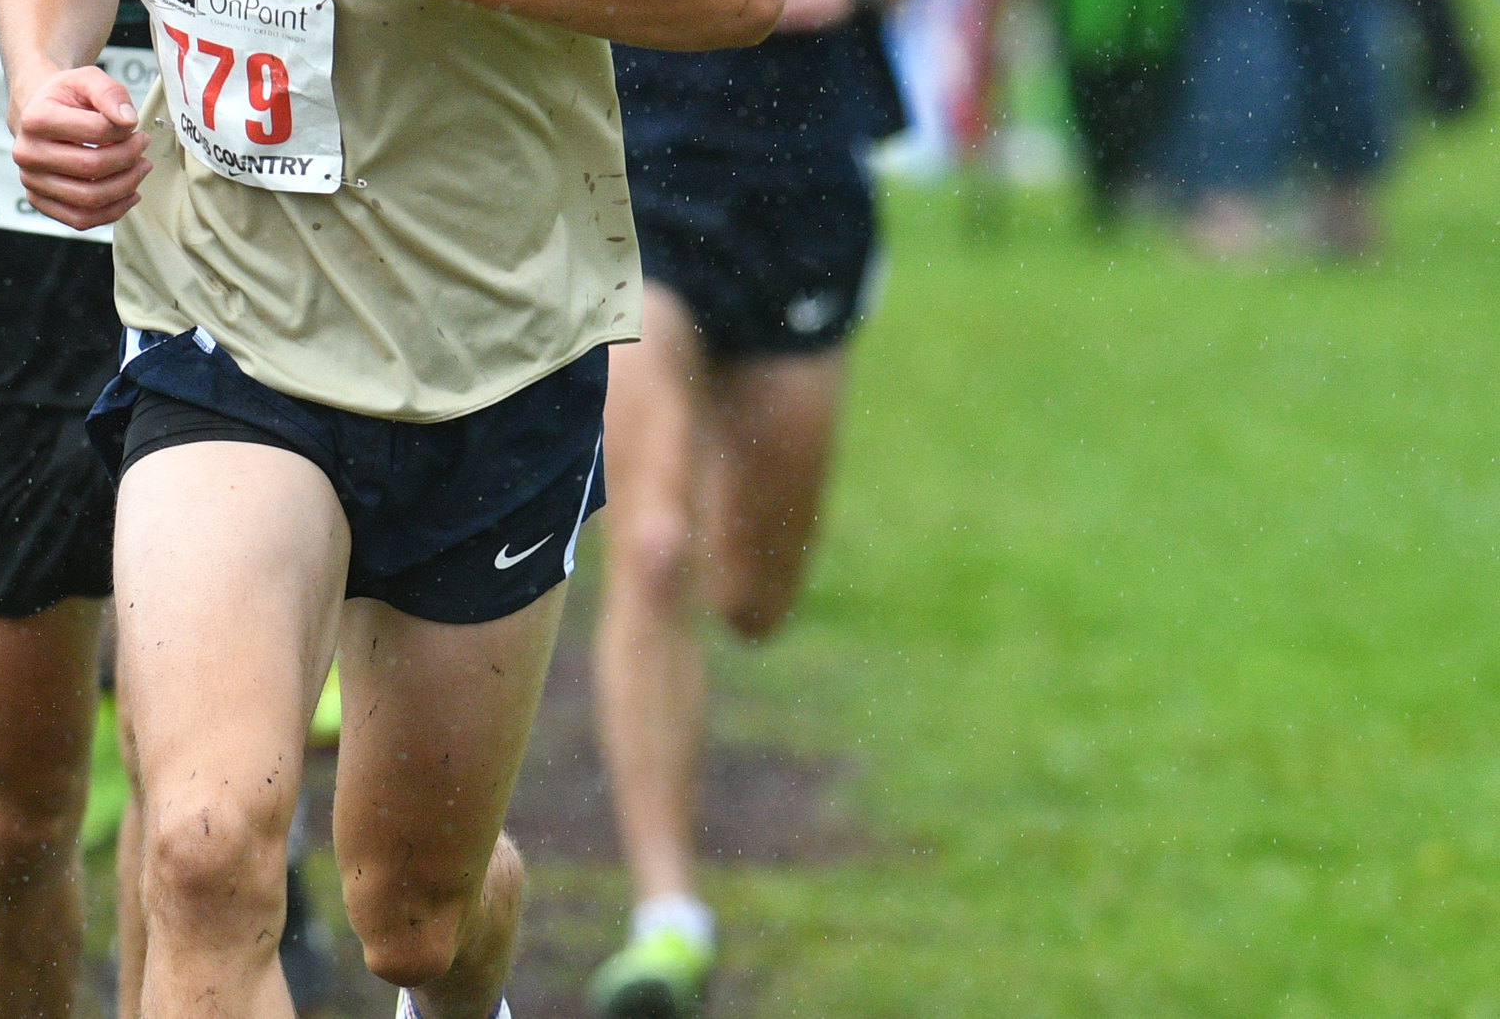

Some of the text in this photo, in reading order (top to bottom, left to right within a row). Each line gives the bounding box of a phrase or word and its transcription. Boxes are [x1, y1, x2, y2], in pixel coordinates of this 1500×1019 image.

[210, 18, 306, 43] COMMUNITY CREDIT UNION
[162, 20, 292, 145] 779
[181, 112, 212, 156] CROS
[213, 144, 314, 175] COUNTRY
